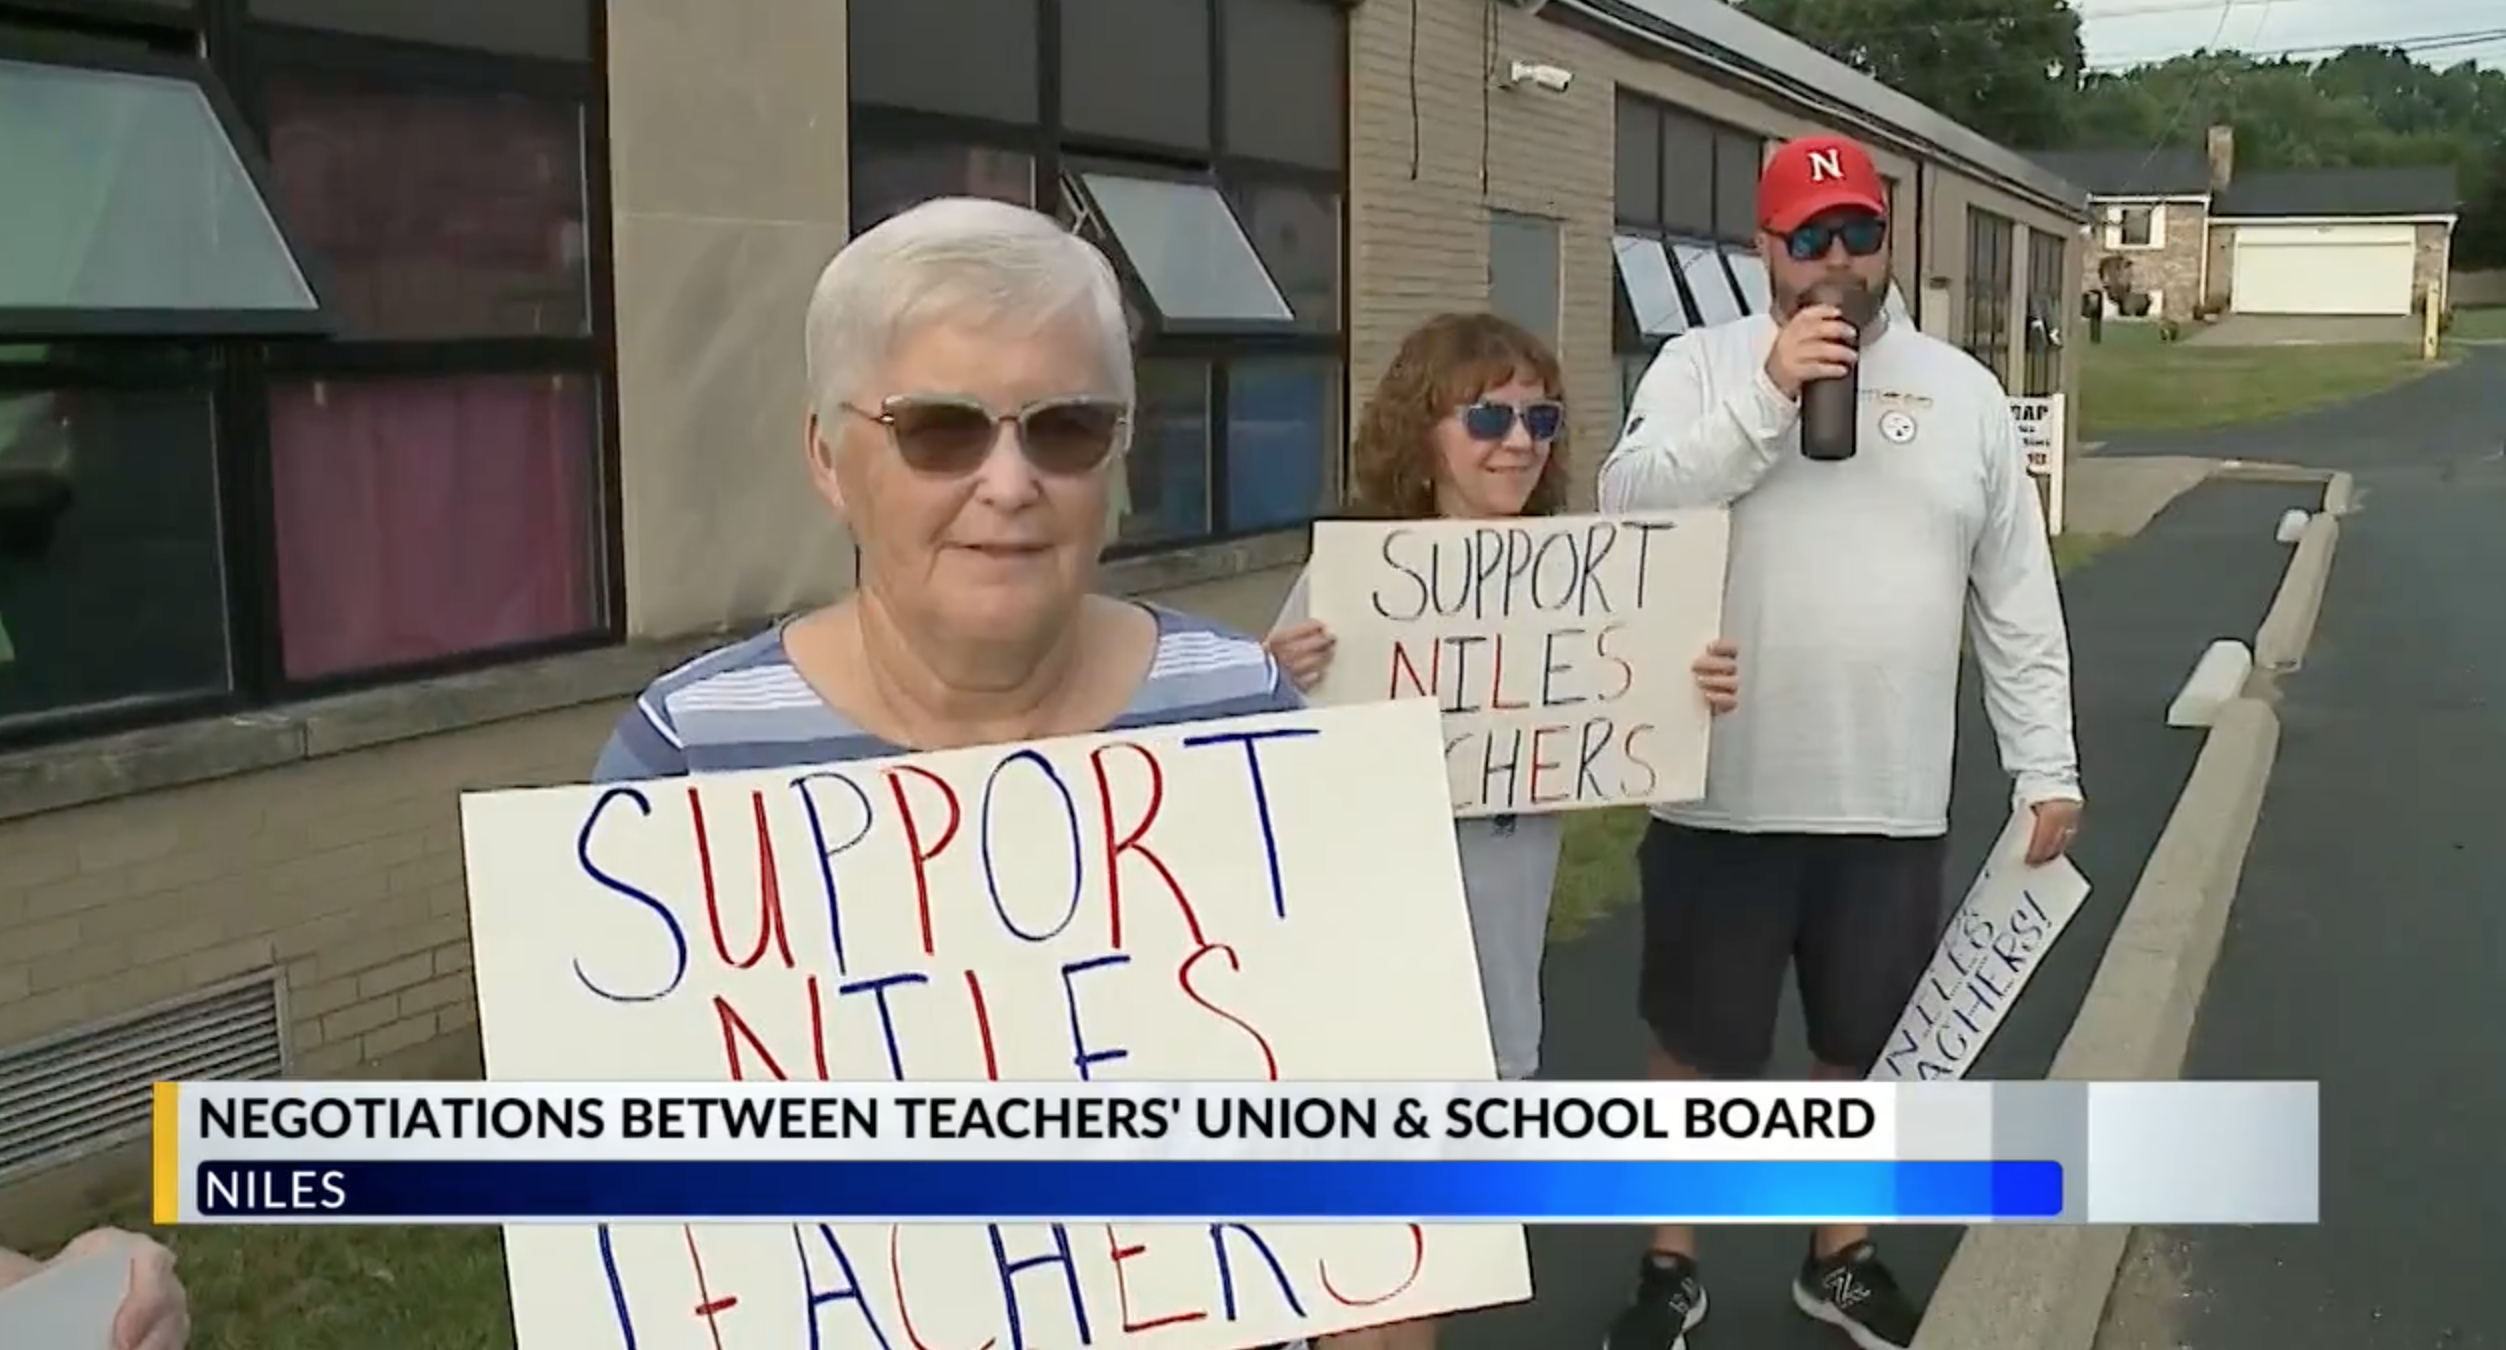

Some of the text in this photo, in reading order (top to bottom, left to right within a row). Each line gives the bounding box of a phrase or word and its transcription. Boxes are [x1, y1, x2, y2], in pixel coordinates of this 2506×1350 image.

[1808, 149, 1843, 181] N
[1373, 521, 1676, 621] SUPPORT
[1390, 622, 1632, 714] NILES
[1445, 717, 1656, 810] CHERS
[572, 728, 1320, 1001] SUPPORT
[1917, 889, 2052, 1080] ACHERS!
